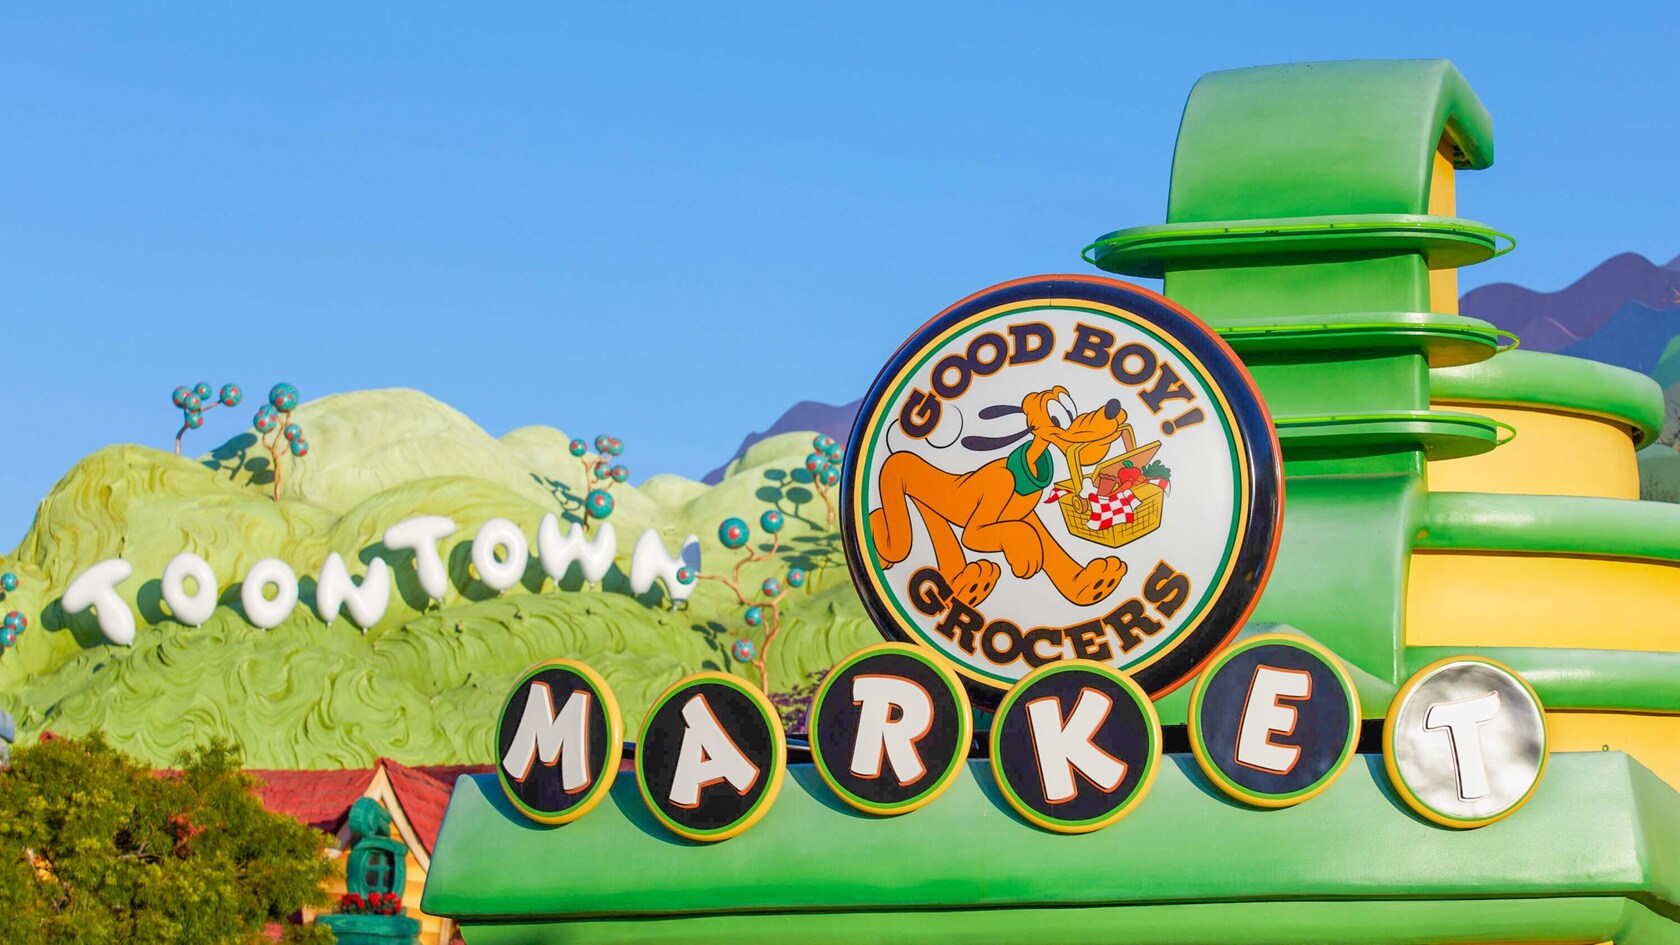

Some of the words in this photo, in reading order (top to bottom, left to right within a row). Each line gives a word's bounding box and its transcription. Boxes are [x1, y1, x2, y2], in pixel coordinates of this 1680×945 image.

[899, 322, 1056, 438] GOOD
[1063, 322, 1206, 437] BOY!
[62, 512, 701, 646] TOONTOWN
[908, 560, 1191, 666] GROCERS
[502, 664, 1500, 808] MARKET
